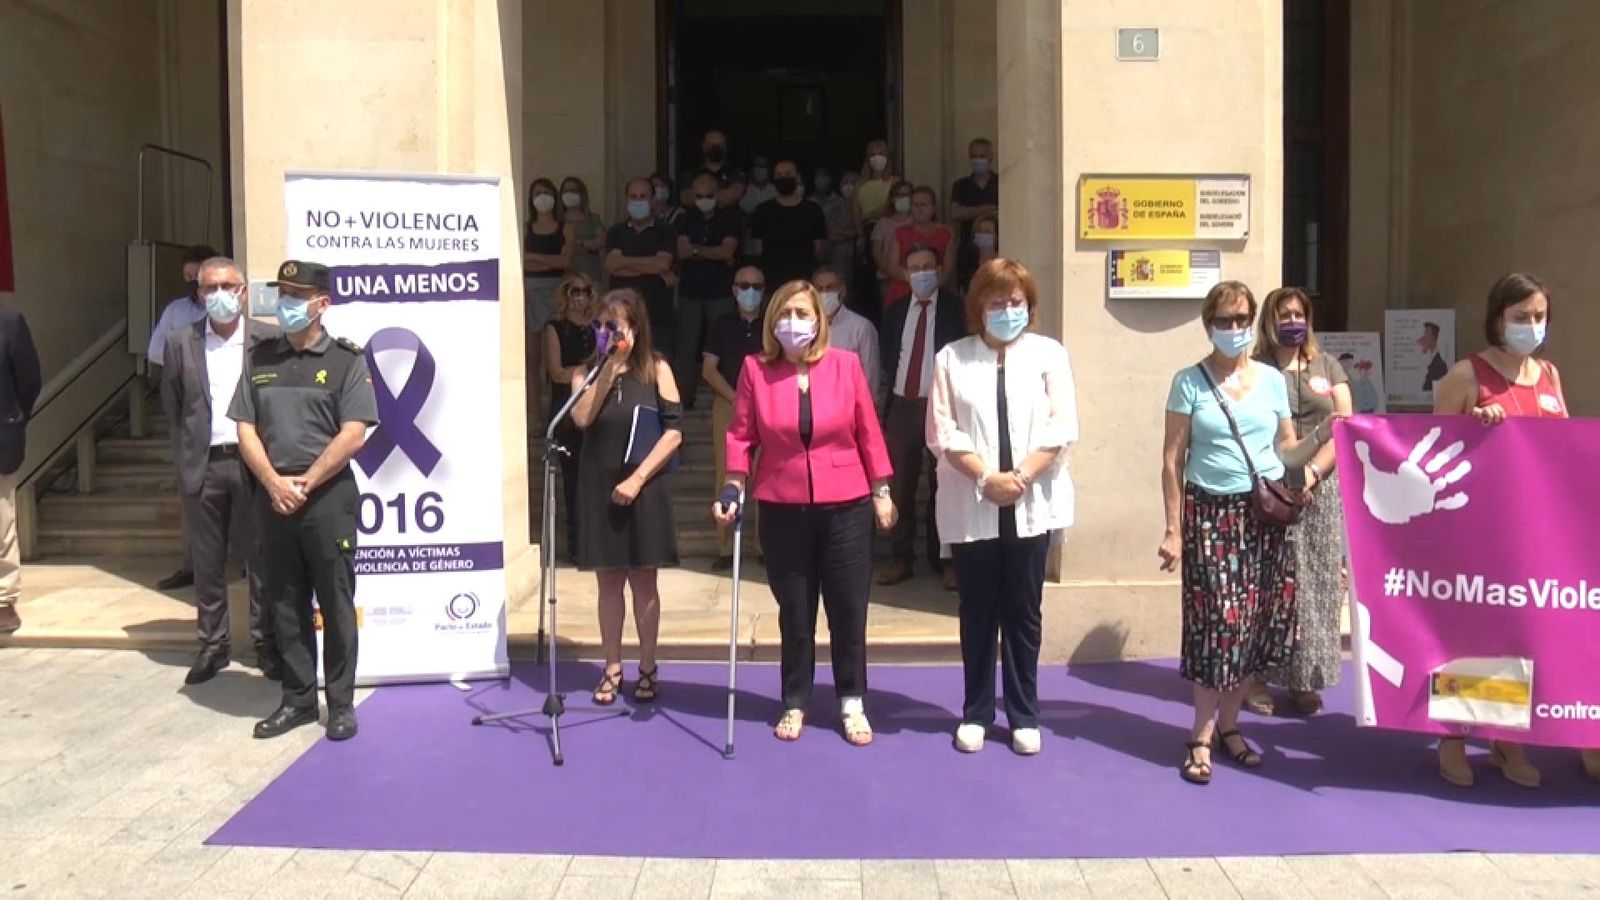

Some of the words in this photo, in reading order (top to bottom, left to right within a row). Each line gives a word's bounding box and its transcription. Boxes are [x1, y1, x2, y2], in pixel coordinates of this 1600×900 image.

[1133, 34, 1144, 53] 6
[1133, 200, 1184, 208] GOBIERNO
[306, 210, 341, 228] NO
[360, 211, 479, 232] VIOLENCIA
[1133, 210, 1146, 219] DE
[1148, 209, 1186, 219] ESPAÑA
[306, 235, 372, 249] CONTRA
[377, 236, 405, 249] LAS
[409, 237, 479, 251] MUJERES
[336, 275, 390, 296] UNA
[394, 272, 480, 294] MENOS
[356, 491, 445, 535] 016
[397, 548, 407, 558] A
[408, 546, 461, 558] VÍCTIMAS
[412, 561, 428, 571] DE
[429, 559, 474, 571] GÉNERO
[1384, 567, 1600, 611] #NoMasViole
